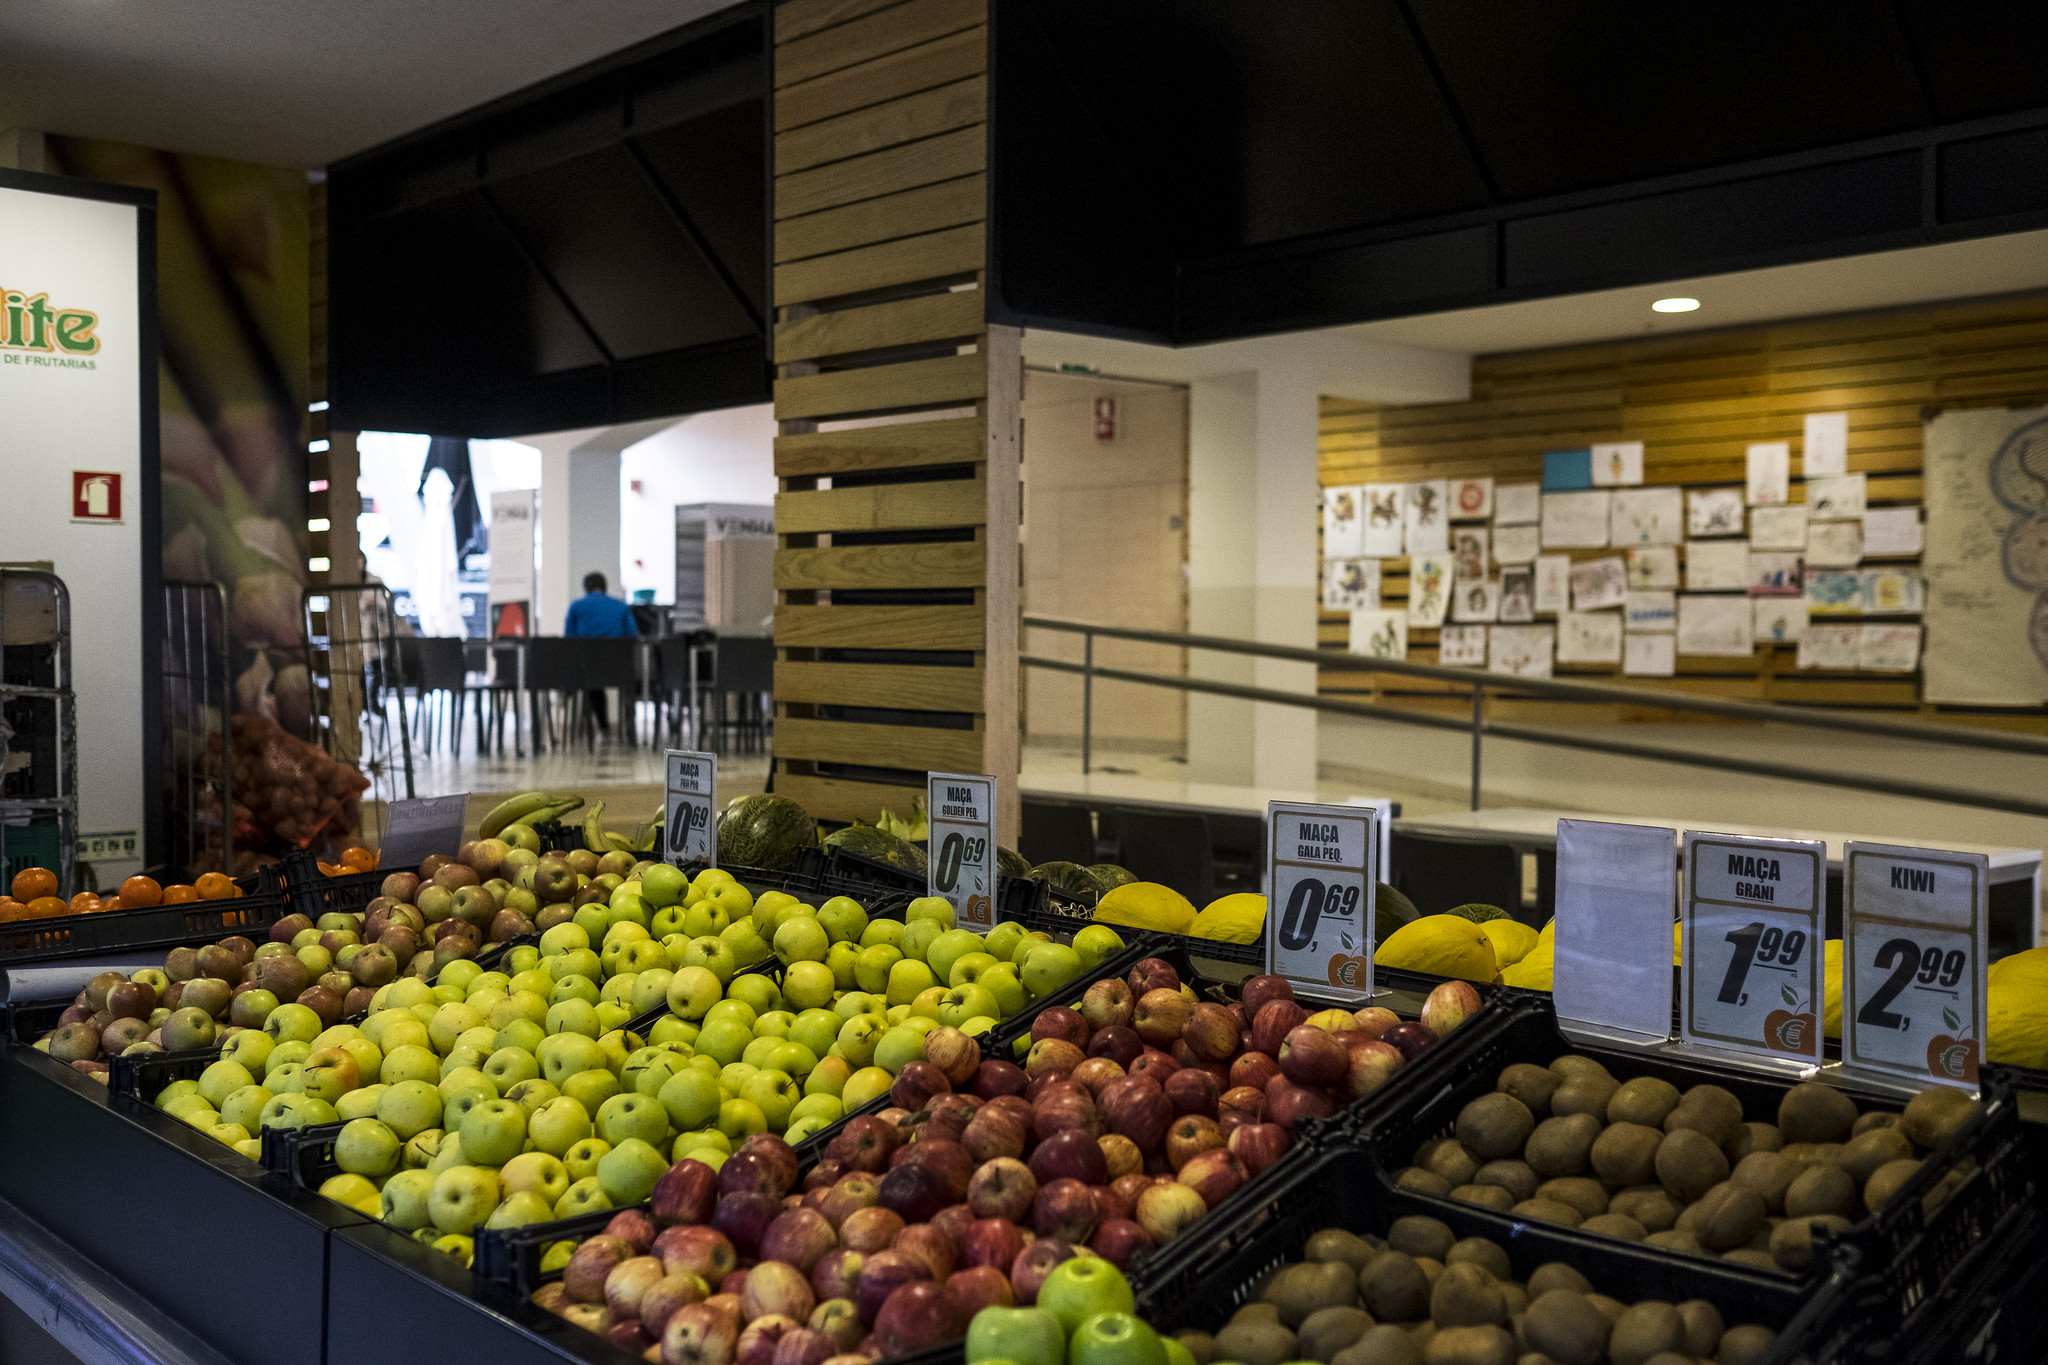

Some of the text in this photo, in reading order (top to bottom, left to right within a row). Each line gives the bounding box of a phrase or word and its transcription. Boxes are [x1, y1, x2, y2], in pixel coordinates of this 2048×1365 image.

[4, 354, 96, 370] DE FRUTARIAS
[680, 762, 700, 779] MAÇA
[947, 786, 972, 805] MAÇA
[942, 804, 979, 820] GOLDEN PEQ.
[1299, 822, 1339, 845] MAÇA
[1297, 845, 1343, 863] GALA PEQ.
[1728, 854, 1781, 883] MAÇA
[1890, 866, 1935, 894] KIWI
[1735, 881, 1775, 902] GRANI
